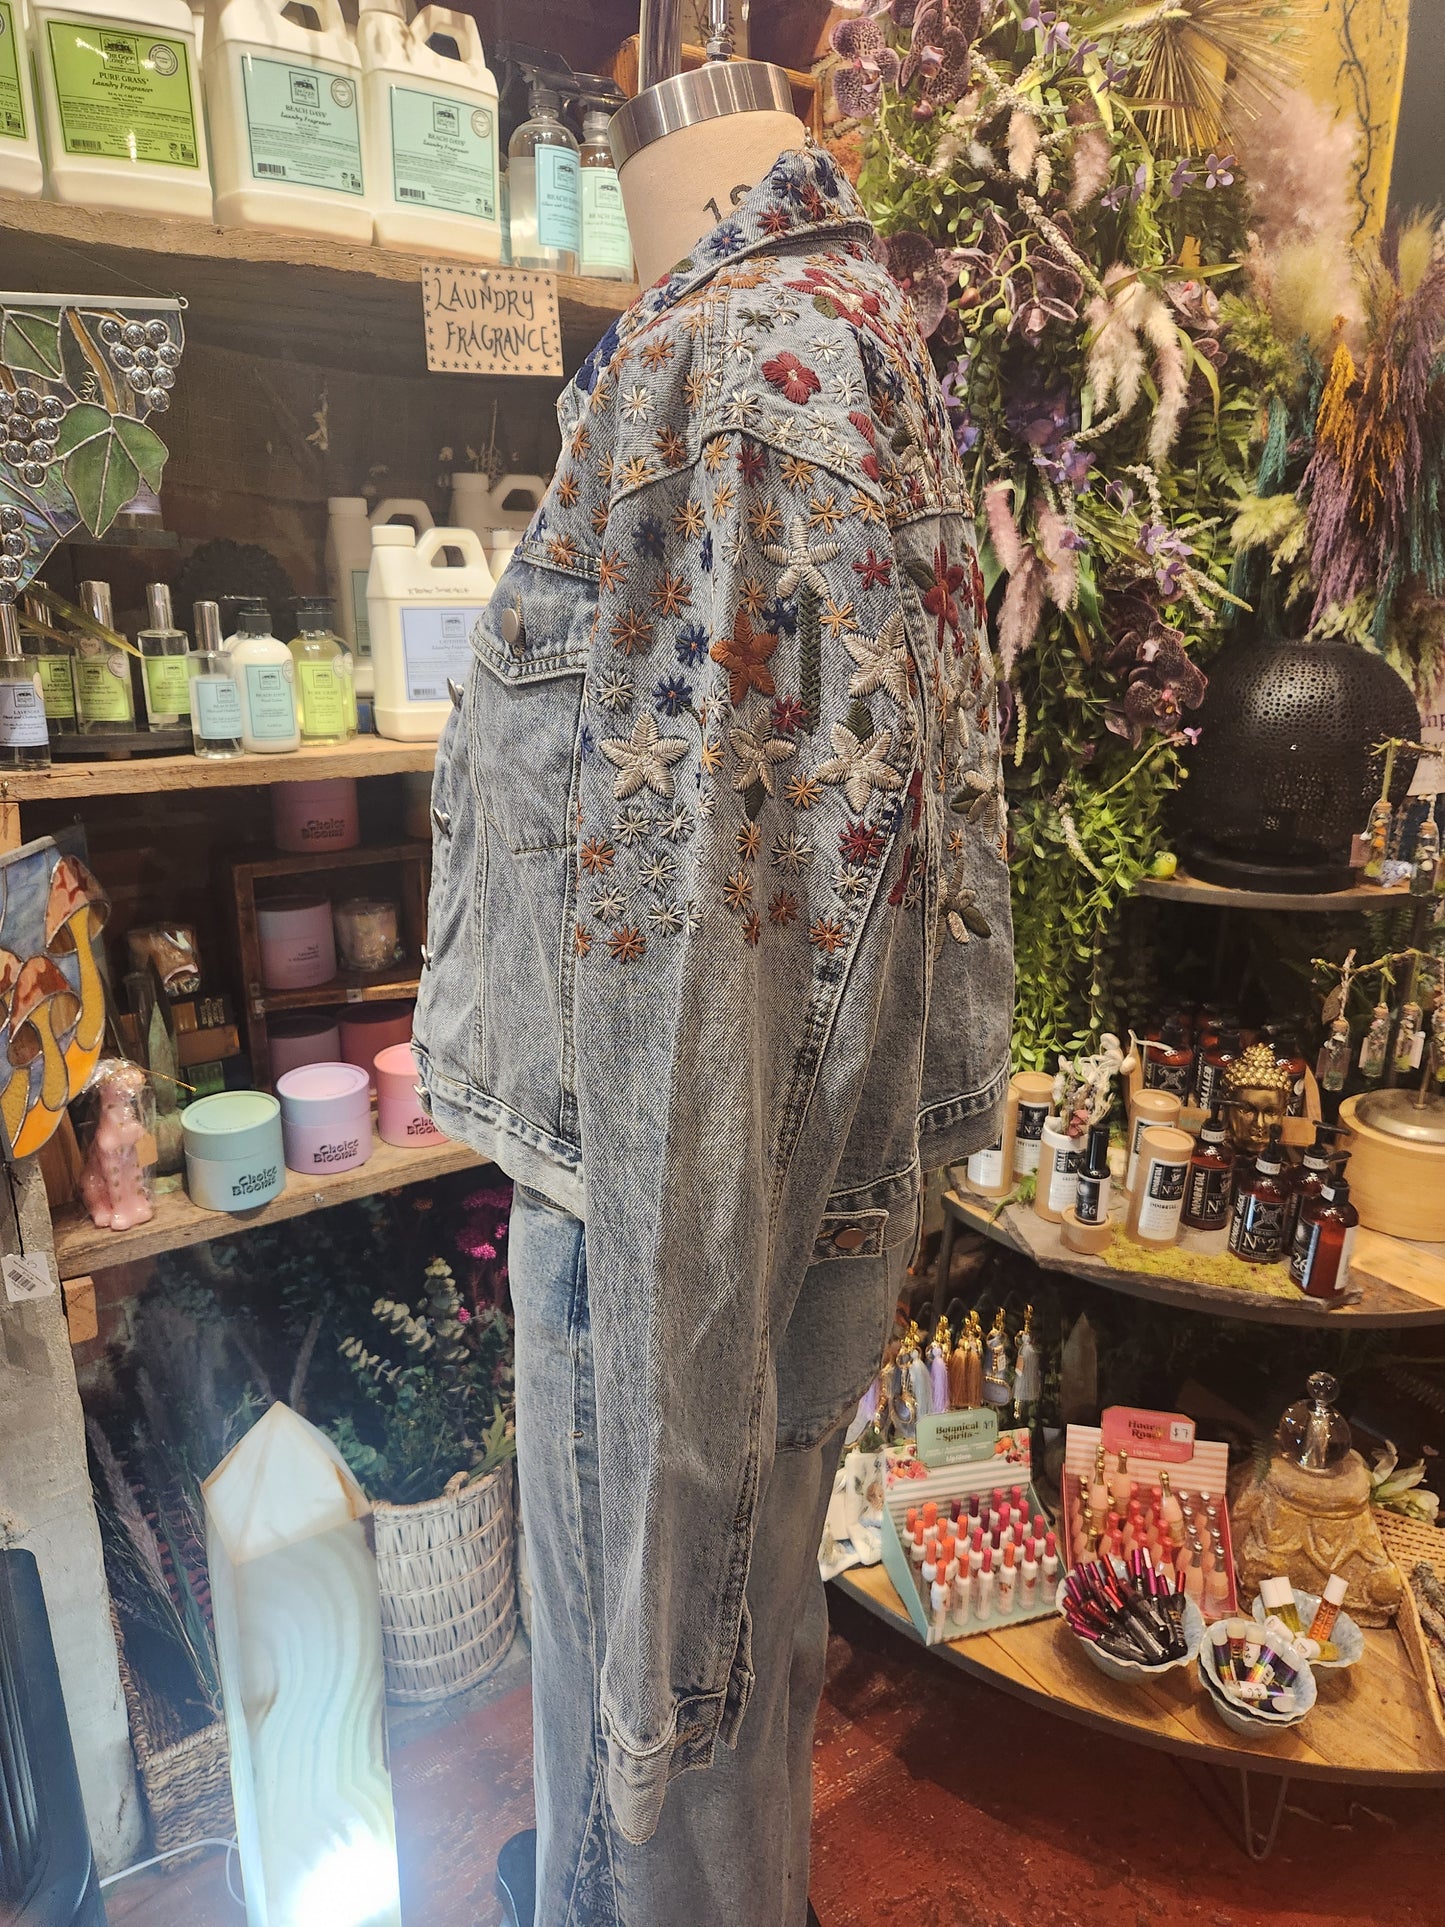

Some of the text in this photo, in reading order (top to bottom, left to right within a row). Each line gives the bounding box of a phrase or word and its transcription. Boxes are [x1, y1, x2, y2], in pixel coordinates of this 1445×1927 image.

[99, 72, 119, 81] PURE
[434, 277, 534, 321] LAUNDRY
[445, 321, 553, 363] FRAGRANCE
[306, 818, 345, 831] Choice
[301, 828, 344, 840] Blooms
[320, 1139, 359, 1154] Choice
[313, 1148, 358, 1163] Blooms
[238, 1165, 278, 1186] Choice
[232, 1175, 277, 1196] Blooms
[1191, 1172, 1206, 1216] IMMORTAL
[1082, 1202, 1096, 1215] 26
[936, 1421, 979, 1434] Botanical
[943, 1430, 973, 1442] Spirits
